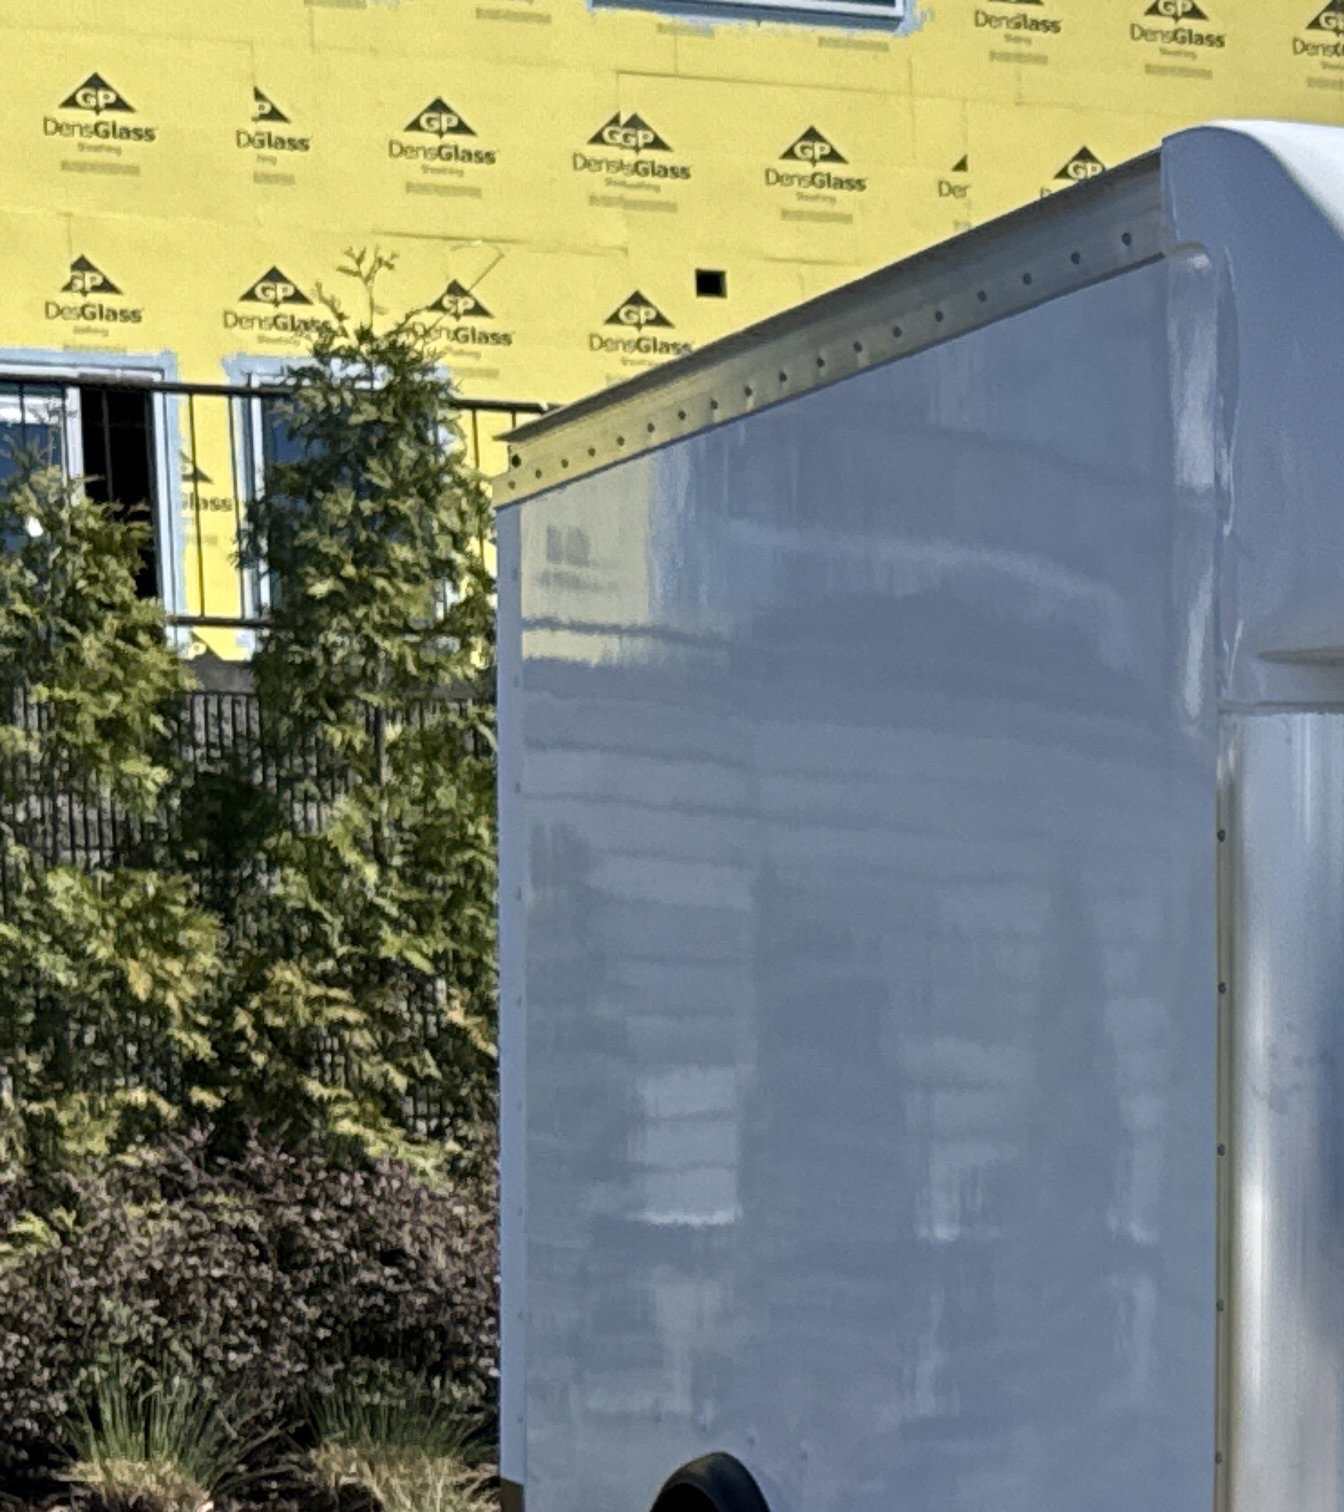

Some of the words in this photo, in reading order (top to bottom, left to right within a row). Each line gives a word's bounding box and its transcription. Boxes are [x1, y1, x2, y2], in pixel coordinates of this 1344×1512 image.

[1130, 23, 1226, 48] DensGlass
[75, 87, 117, 110] GP
[43, 116, 157, 142] DensGlass
[419, 111, 459, 133] GP
[388, 139, 497, 165] DensGlass
[794, 141, 831, 162] GP
[764, 168, 867, 192] DensGlass
[253, 281, 297, 302] GP
[618, 304, 657, 325] GP
